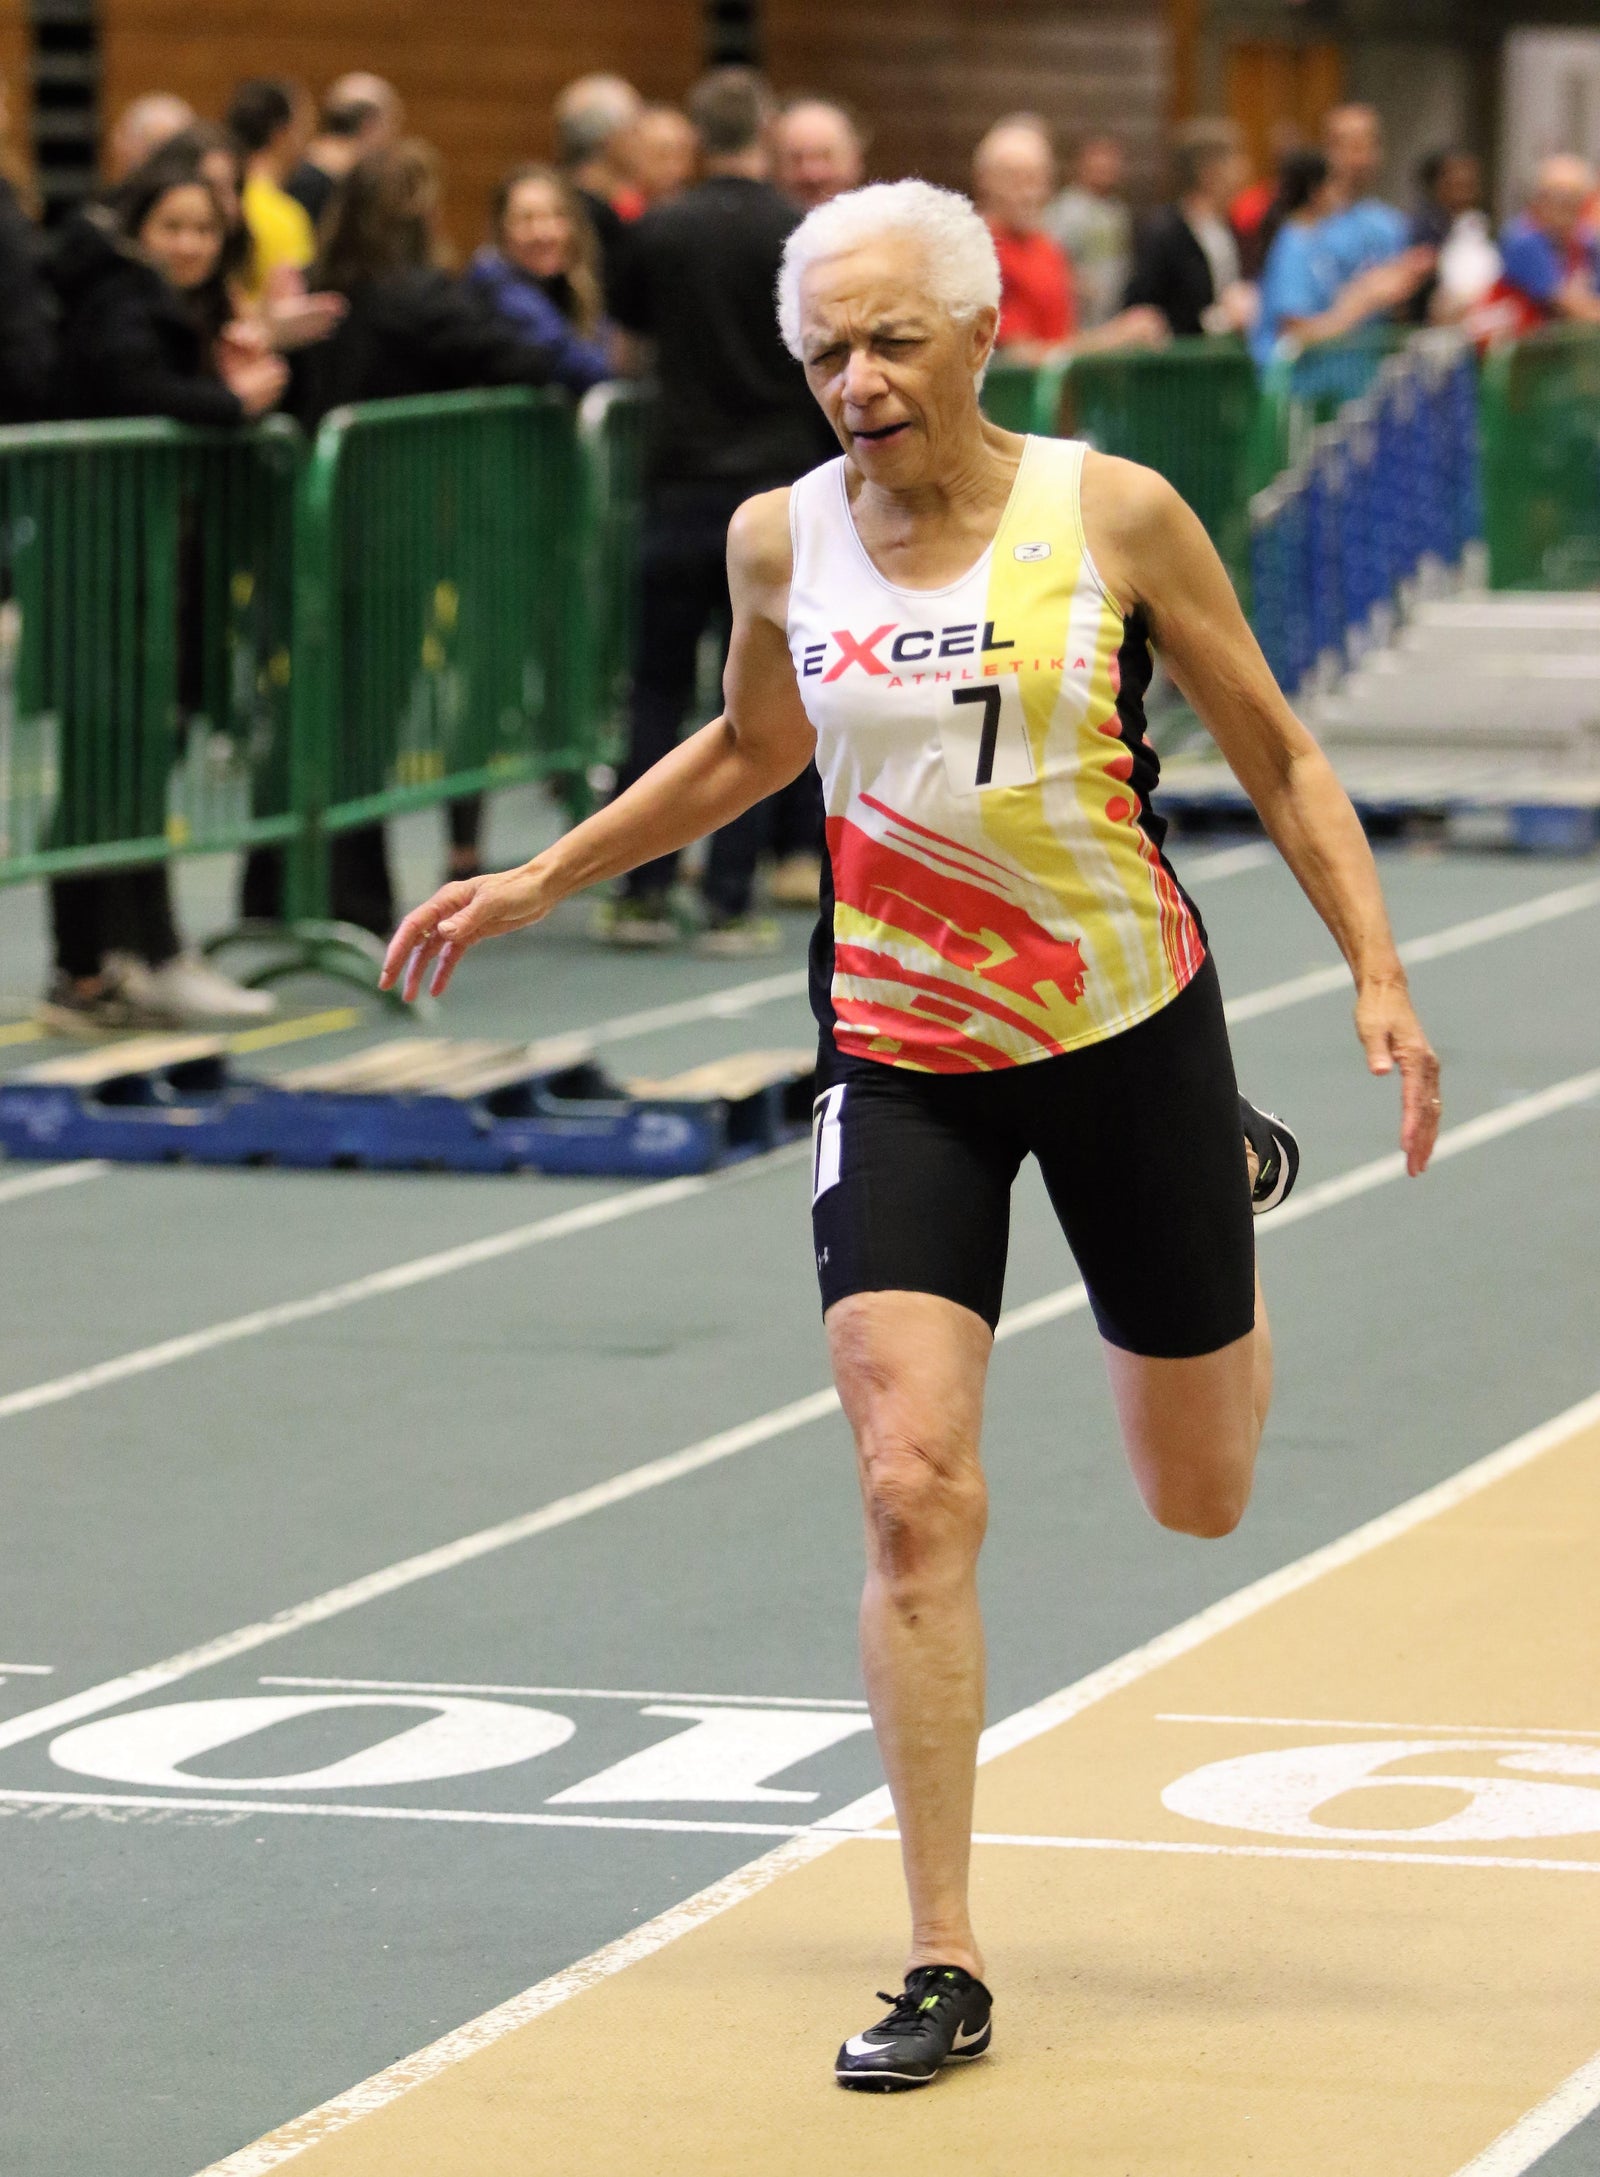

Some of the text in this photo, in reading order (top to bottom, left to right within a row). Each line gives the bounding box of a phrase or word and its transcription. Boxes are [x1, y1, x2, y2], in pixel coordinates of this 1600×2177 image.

[803, 621, 1015, 683] EXCEL
[887, 657, 1087, 688] ATHLETIKA
[952, 684, 1001, 786] 7
